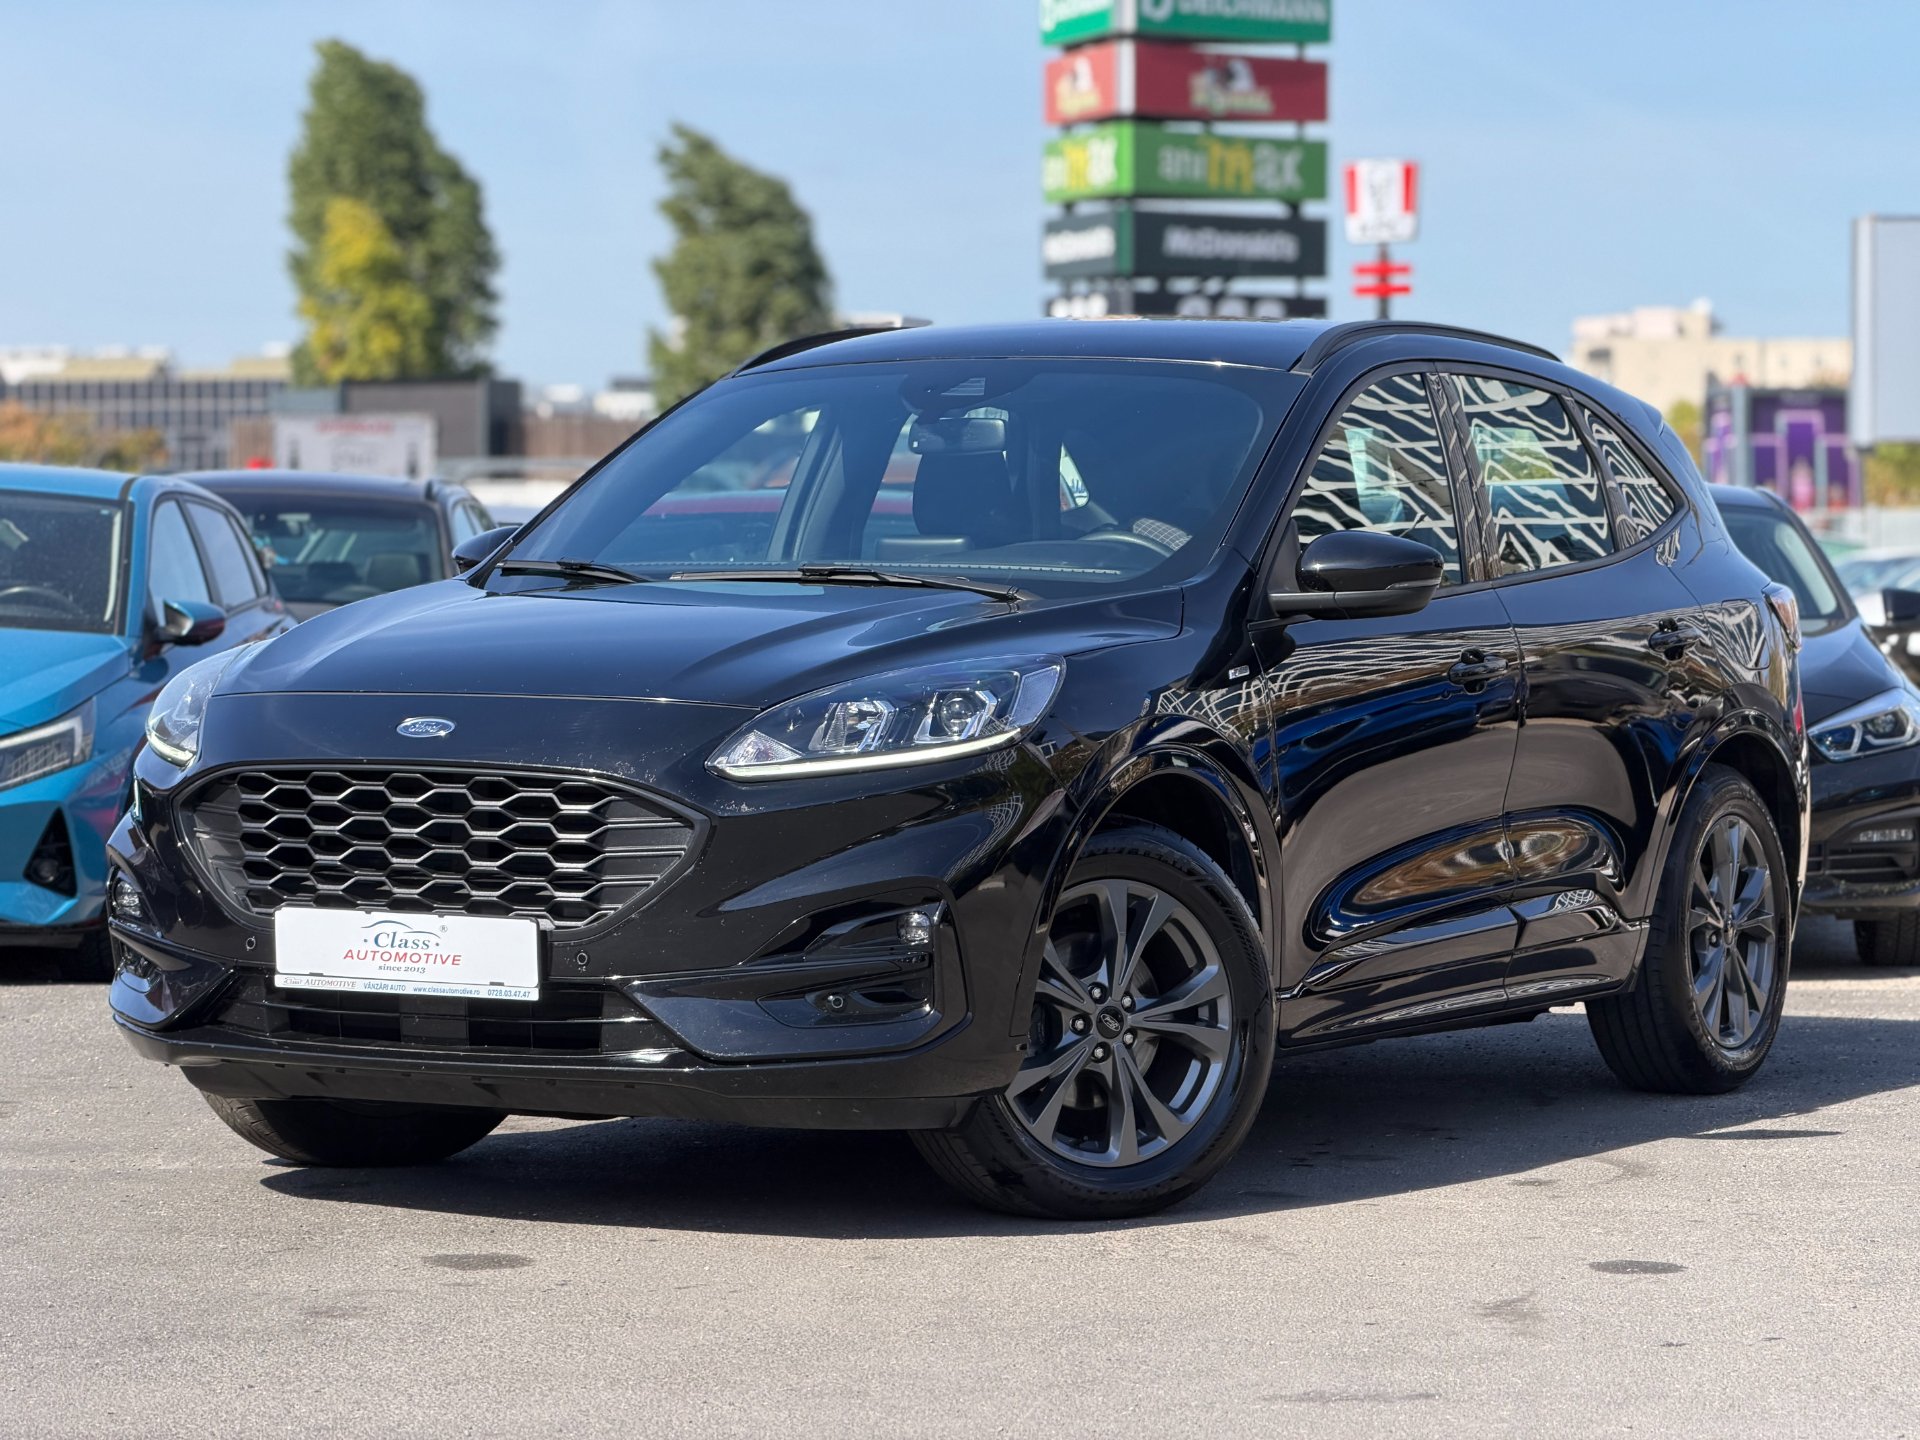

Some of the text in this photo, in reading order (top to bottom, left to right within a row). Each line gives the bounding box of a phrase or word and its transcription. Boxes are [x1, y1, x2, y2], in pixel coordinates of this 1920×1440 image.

[374, 931, 431, 950] Class
[343, 949, 462, 966] AUTOMOTIVE
[378, 964, 426, 974] since 2013
[304, 978, 357, 988] AUTOMOTIVE
[390, 983, 406, 992] AUTO
[412, 985, 481, 996] www.classautomotive.ro
[487, 989, 531, 999] 0728.03.47.47
